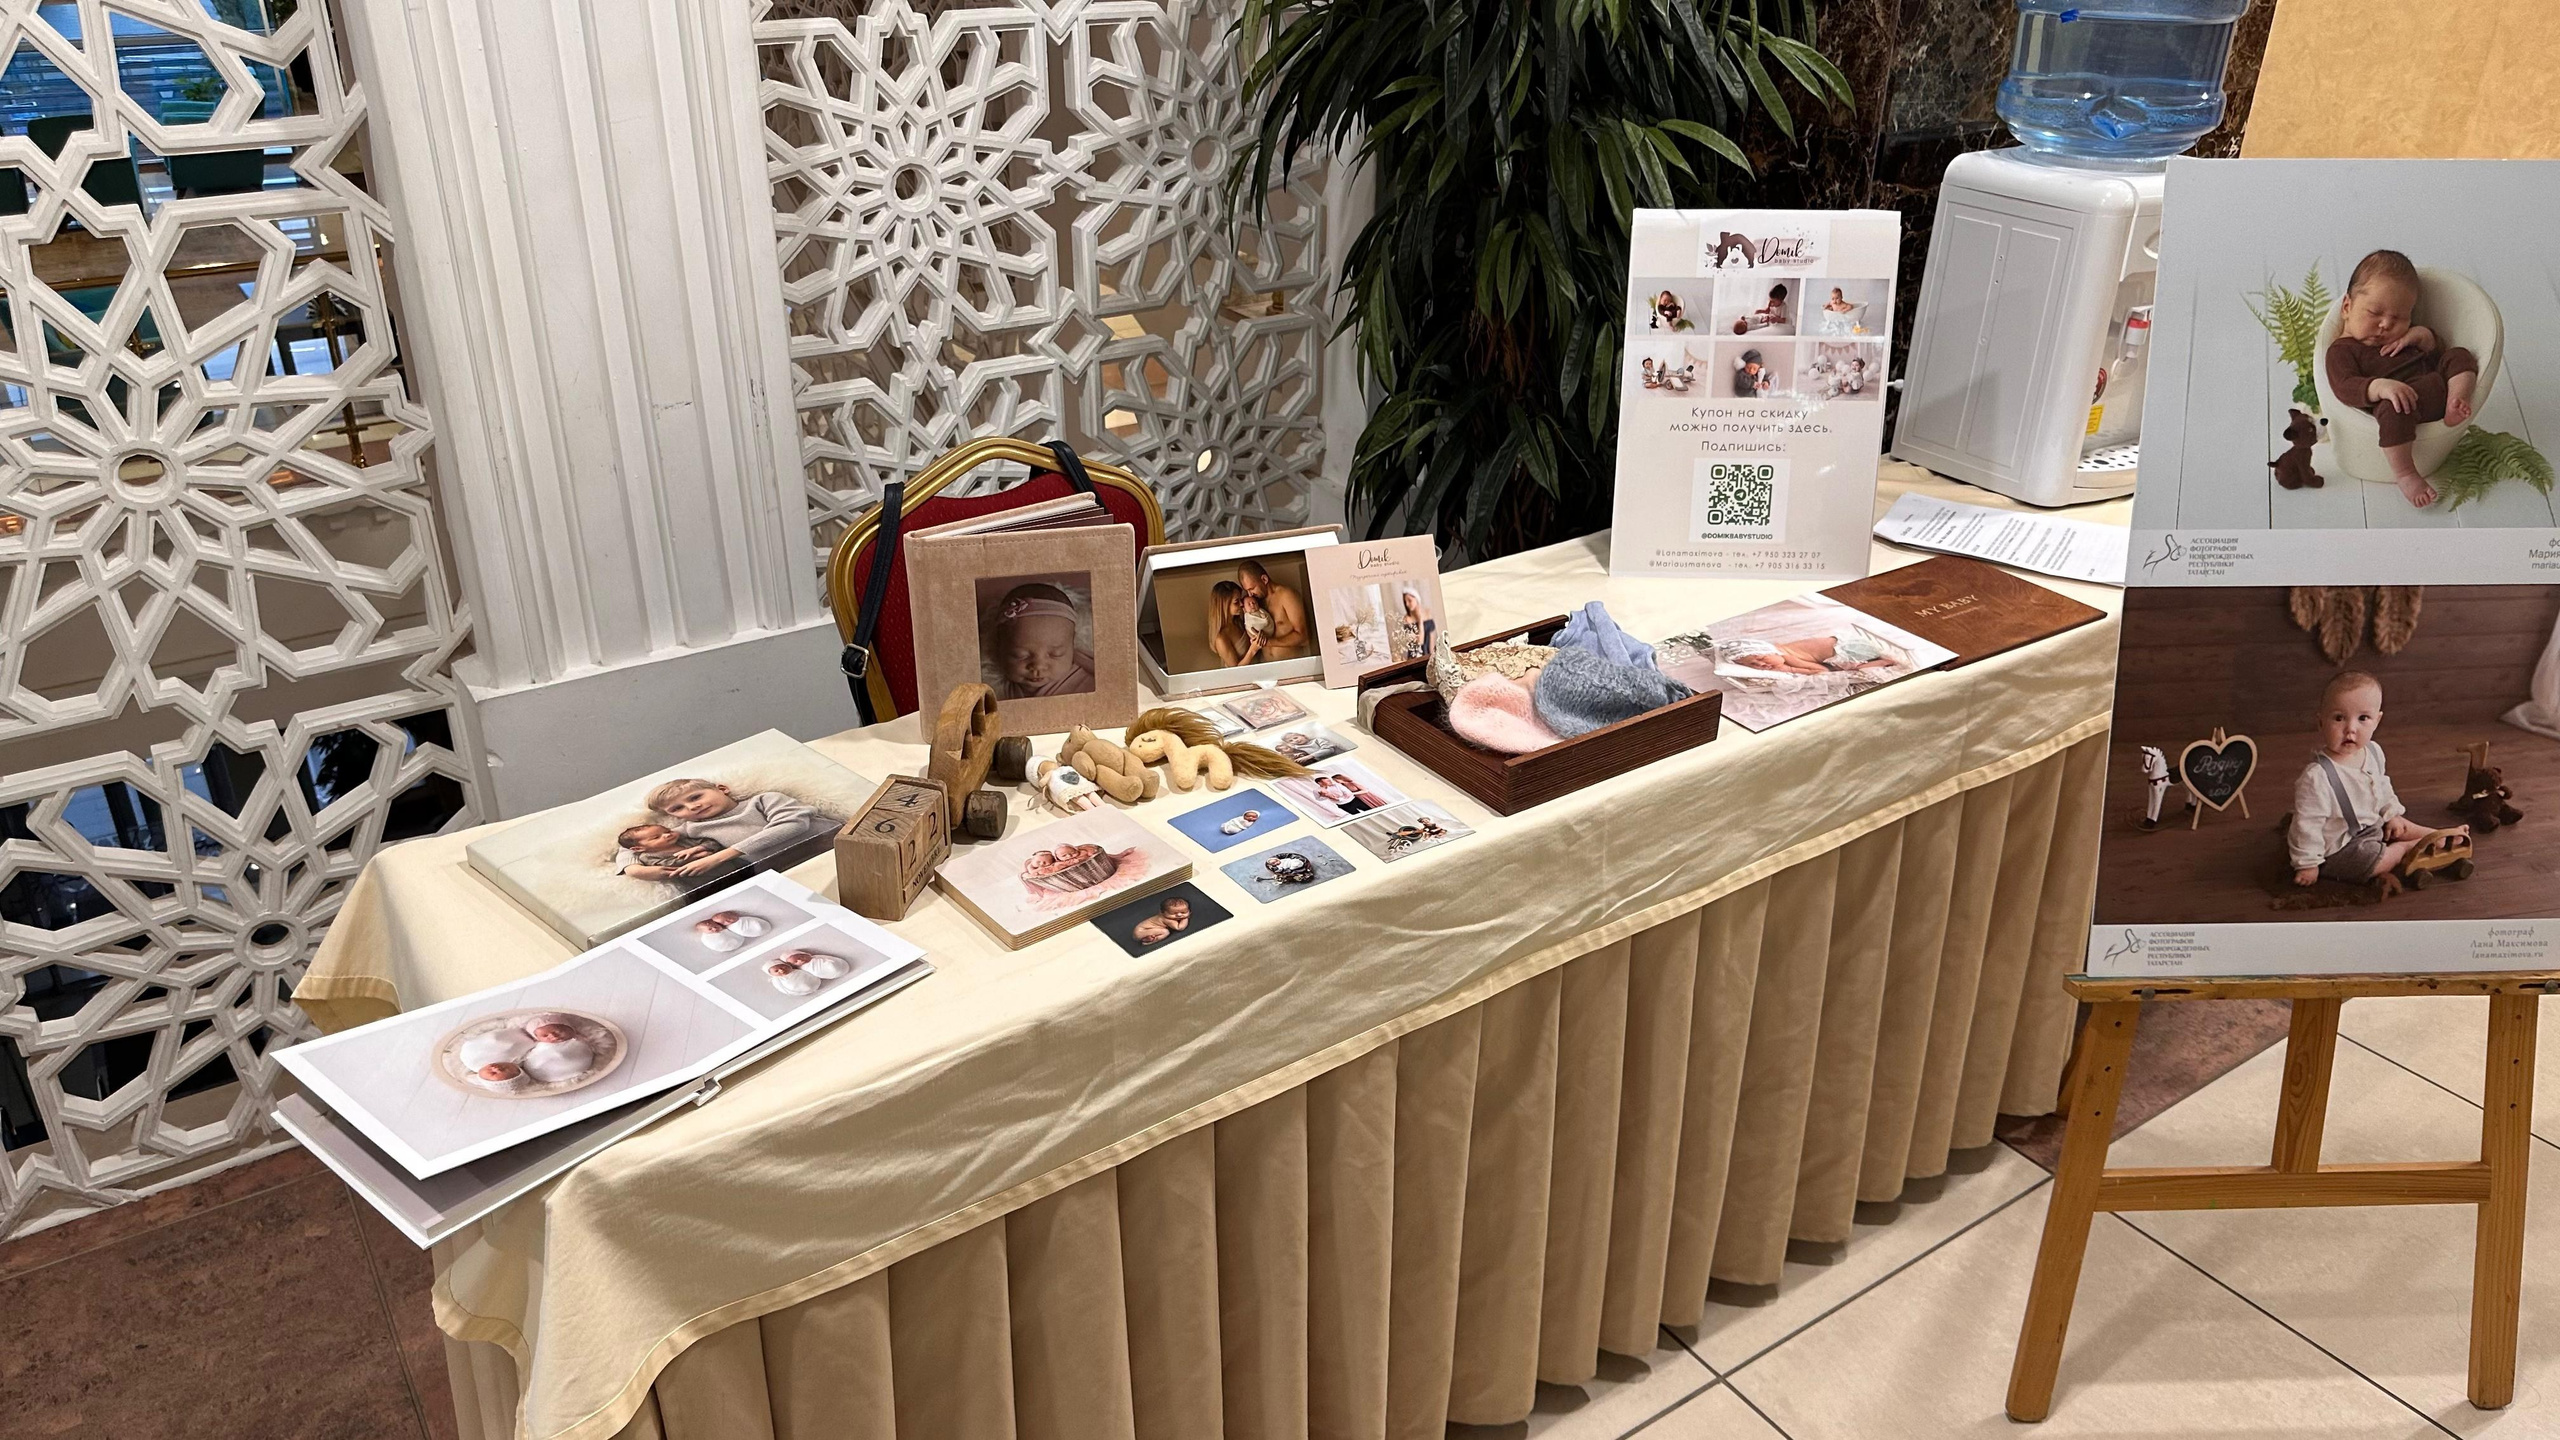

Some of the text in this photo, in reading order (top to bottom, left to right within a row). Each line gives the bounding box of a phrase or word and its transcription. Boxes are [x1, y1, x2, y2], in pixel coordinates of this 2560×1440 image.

[1757, 237, 1804, 264] Domik
[1691, 407, 1808, 420] Купон на скидку
[1669, 423, 1832, 434] можно получить здесь.
[1701, 441, 1786, 452] Подпишись:
[1701, 532, 1773, 540] @DOMIKBABYSTUDIO
[1914, 606, 1941, 618] MY
[1939, 594, 1979, 610] BABY
[875, 793, 919, 833] 6 4
[908, 811, 938, 870] 2 2
[2487, 926, 2535, 939] фотограф
[2470, 939, 2549, 948] Лана Максимова
